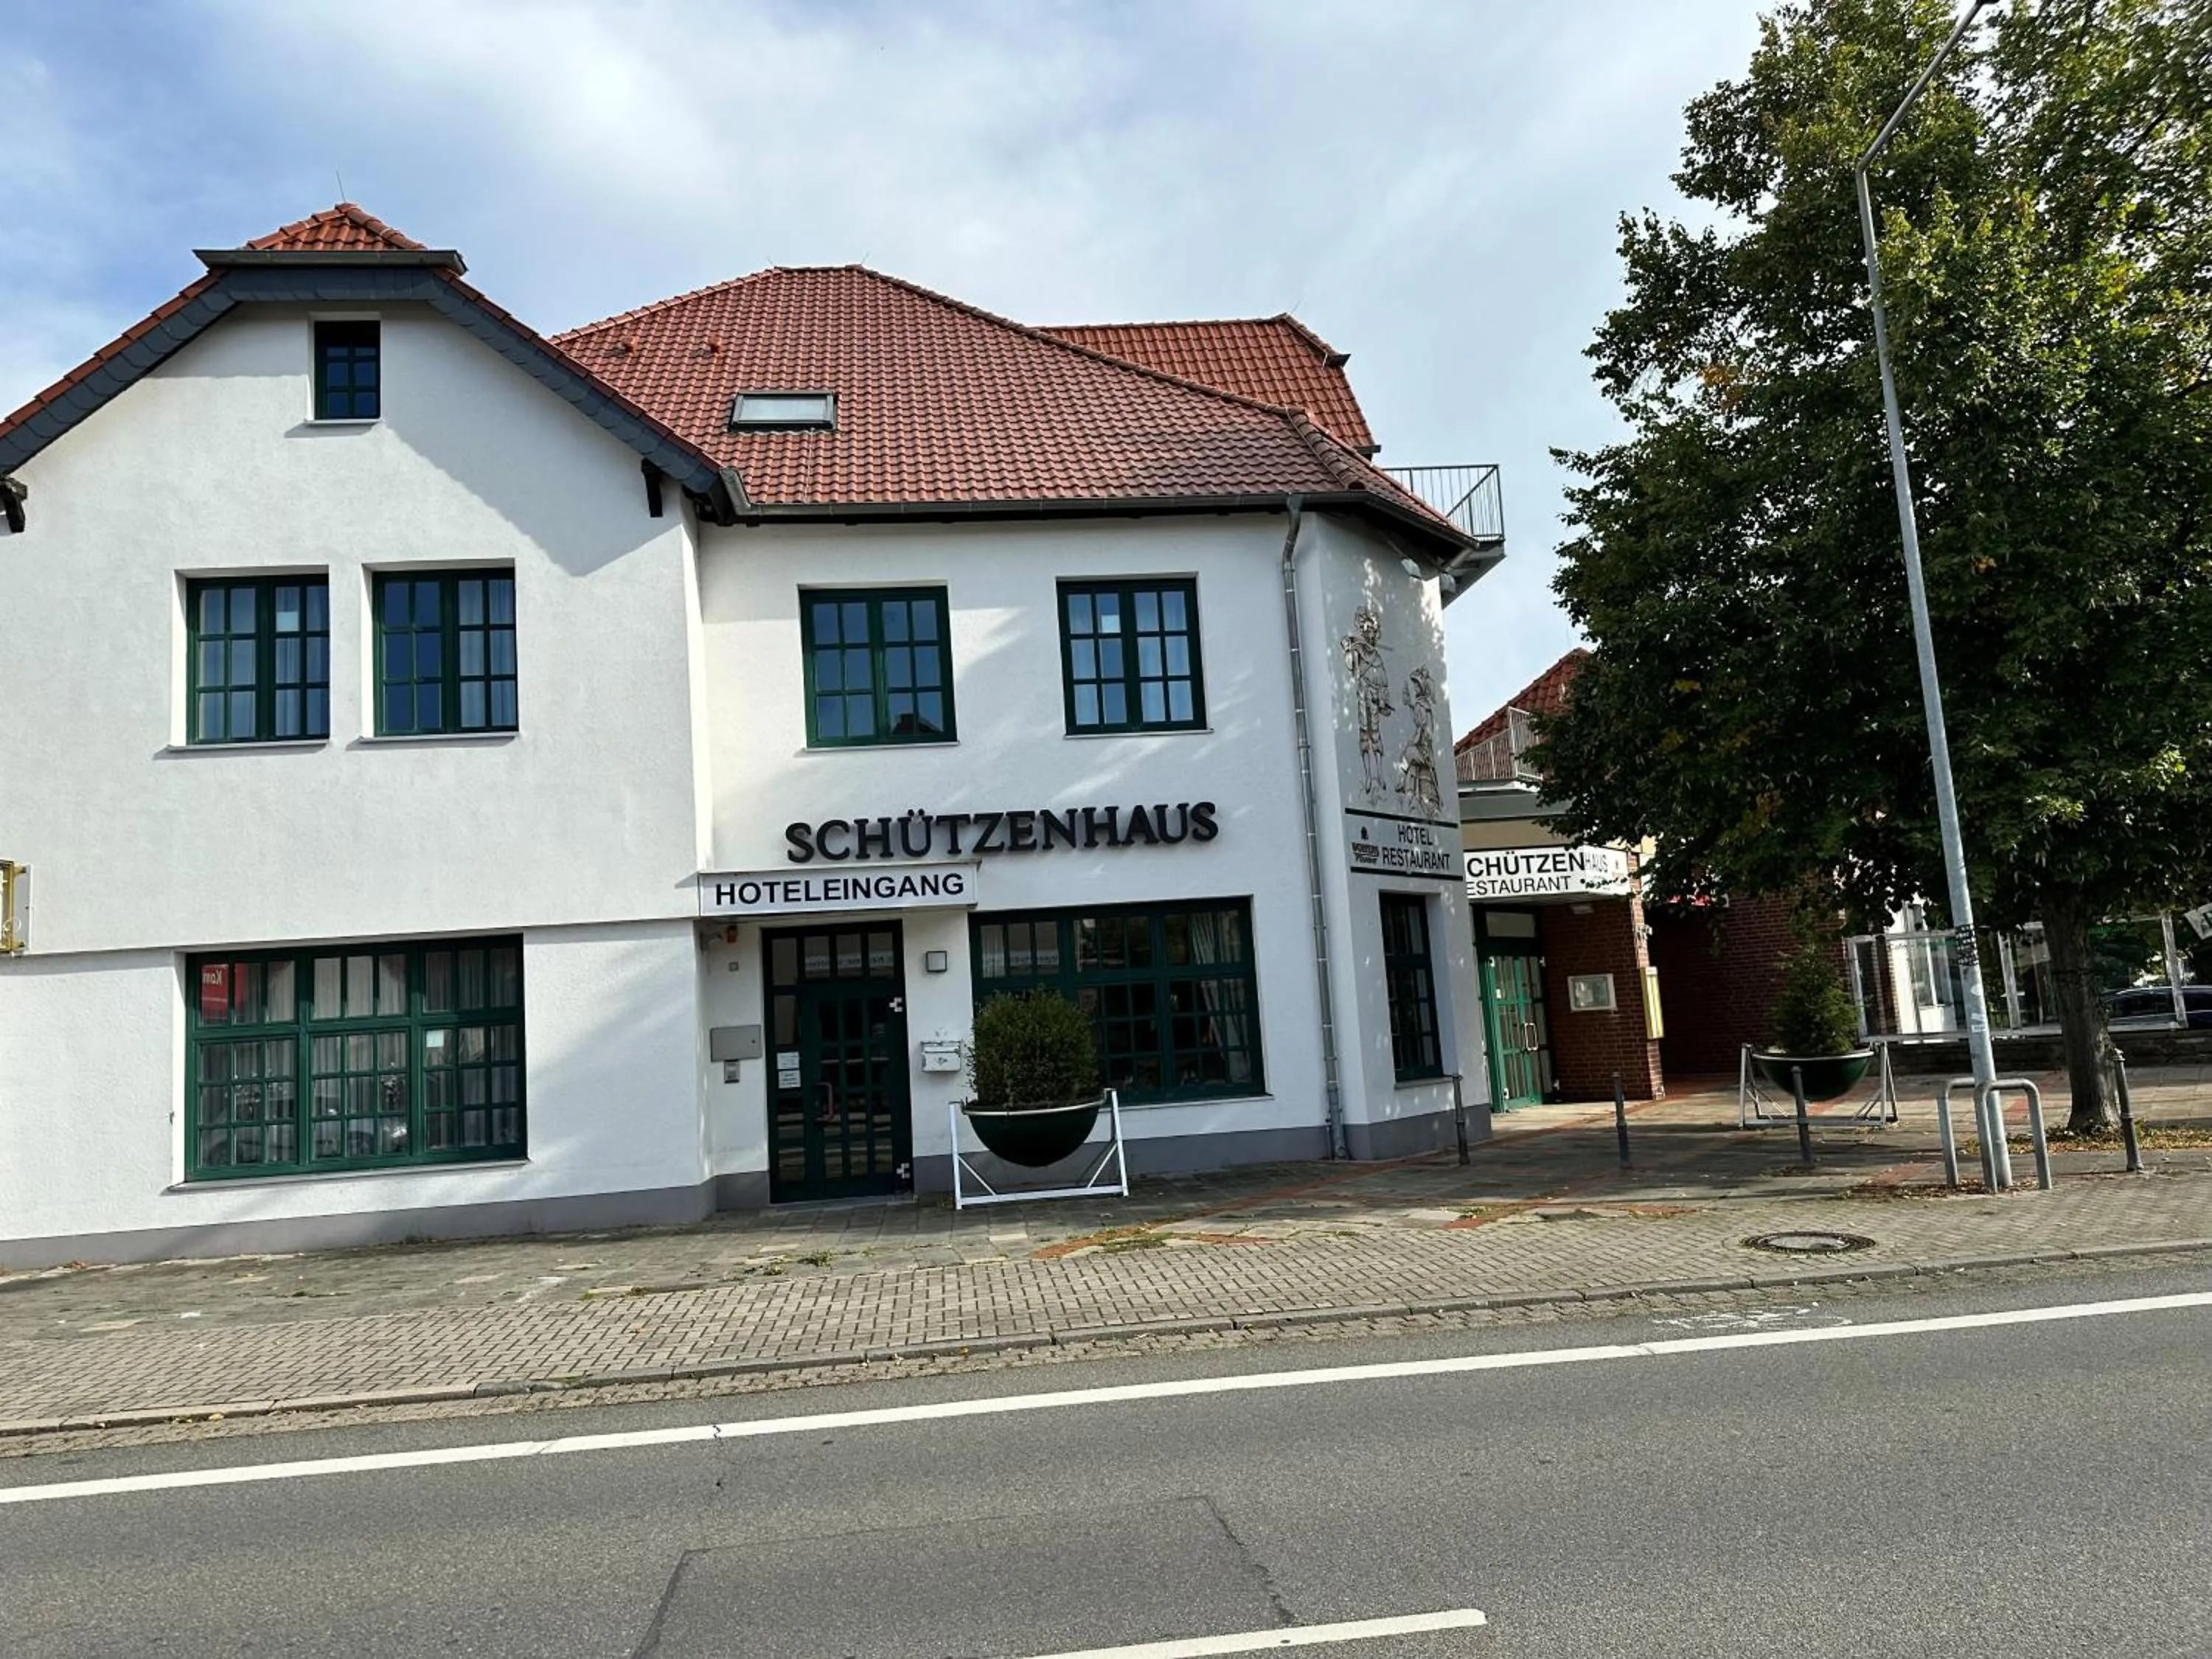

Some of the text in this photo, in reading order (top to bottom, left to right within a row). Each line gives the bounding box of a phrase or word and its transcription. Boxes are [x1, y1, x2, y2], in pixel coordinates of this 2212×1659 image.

[785, 801, 1219, 863] SCHÜTZENHAUS
[1397, 824, 1433, 846] HOTEL
[1381, 847, 1450, 871] RESTAURANT
[715, 872, 965, 906] HOTELEINGANG
[1467, 875, 1571, 896] ESTAURANT
